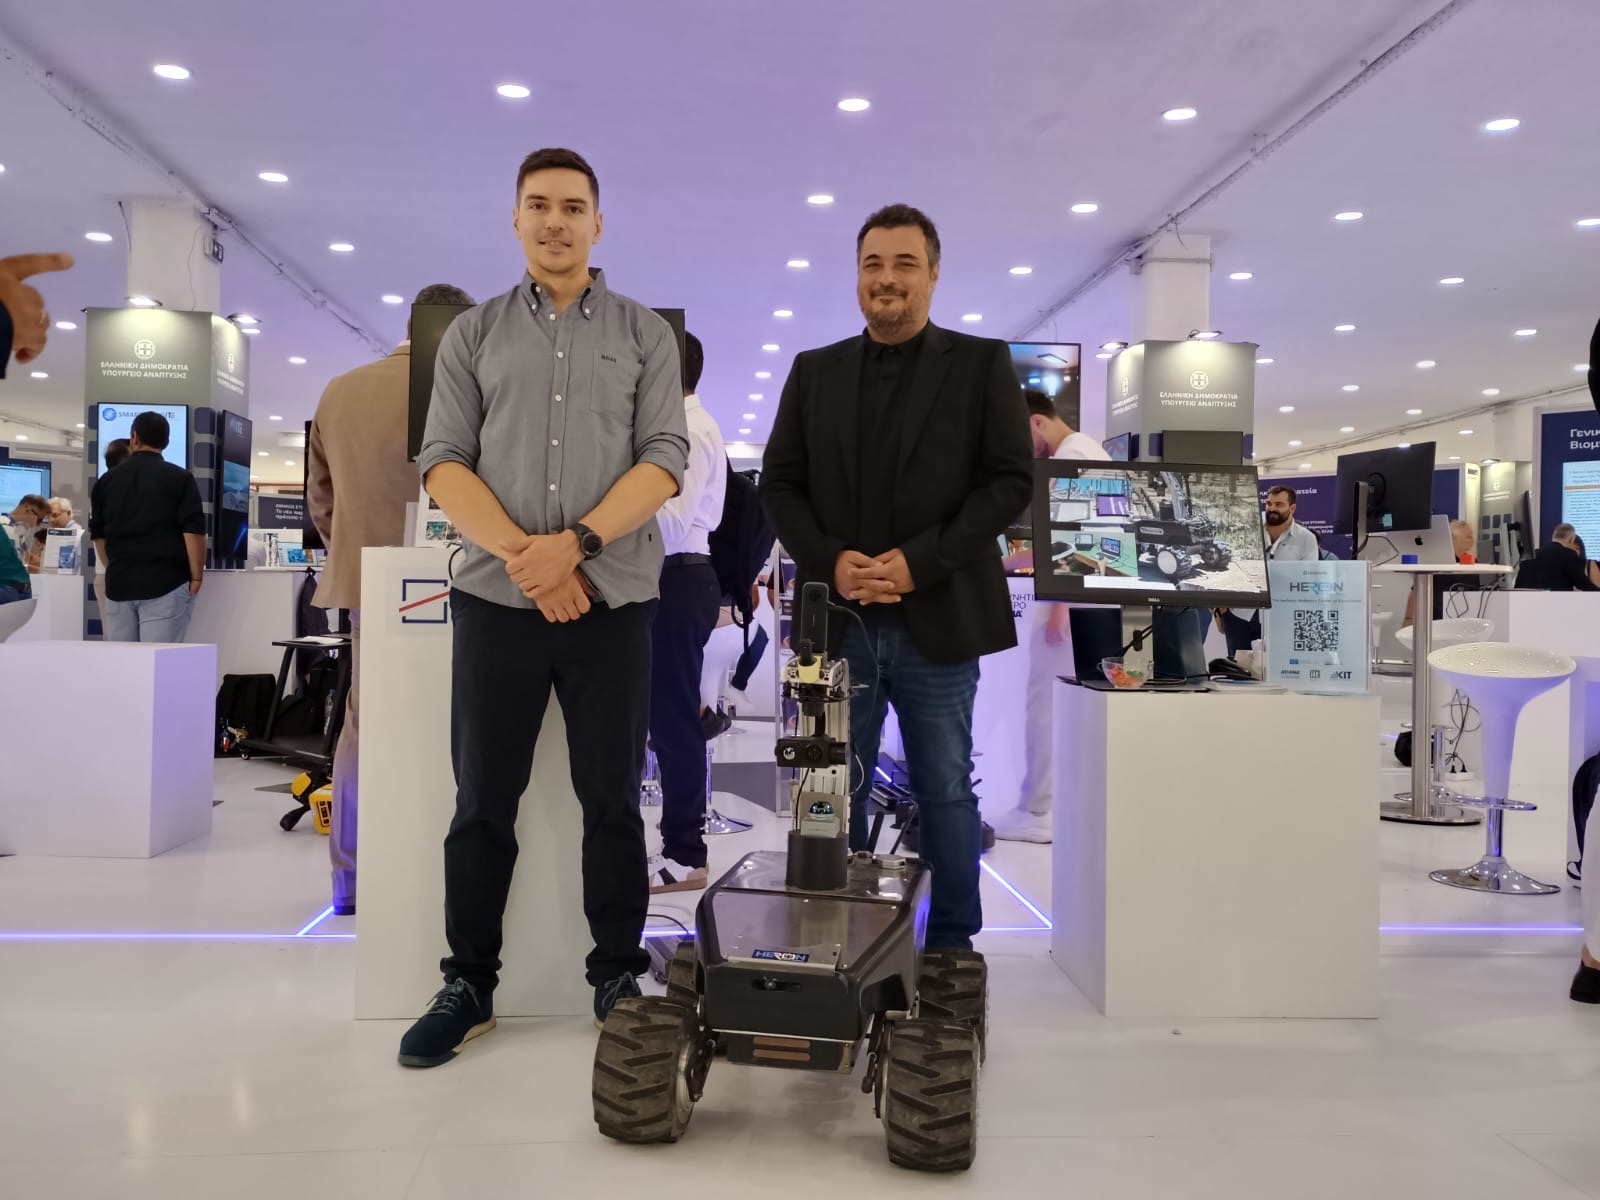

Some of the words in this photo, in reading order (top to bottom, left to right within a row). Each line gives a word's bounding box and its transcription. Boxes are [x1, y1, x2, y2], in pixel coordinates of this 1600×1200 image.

[100, 361, 138, 369] ΕΛΛΗΝΙΚΗ
[139, 362, 189, 371] ΔΗΜΟΚΡΑΤΙΑ
[102, 369, 141, 378] ΥΠΟΥΡΓΕΙΟ
[143, 370, 187, 379] ΑΝΑΠΤΥΞΗΣ
[1160, 391, 1193, 399] ΕΛΛΗΝΙΚΗ
[1194, 392, 1238, 400] ΔΗΜΟΚΡΑΤΙΑ
[1161, 399, 1196, 407] ΥΠΟΥΡΓΕΙΟ
[1197, 400, 1237, 408] ΑΝΑΠΤΥΞΗΣ
[1570, 440, 1600, 450] Βιομ
[1289, 582, 1343, 594] HERON
[1336, 671, 1352, 679] KIT
[755, 951, 806, 960] HERON
